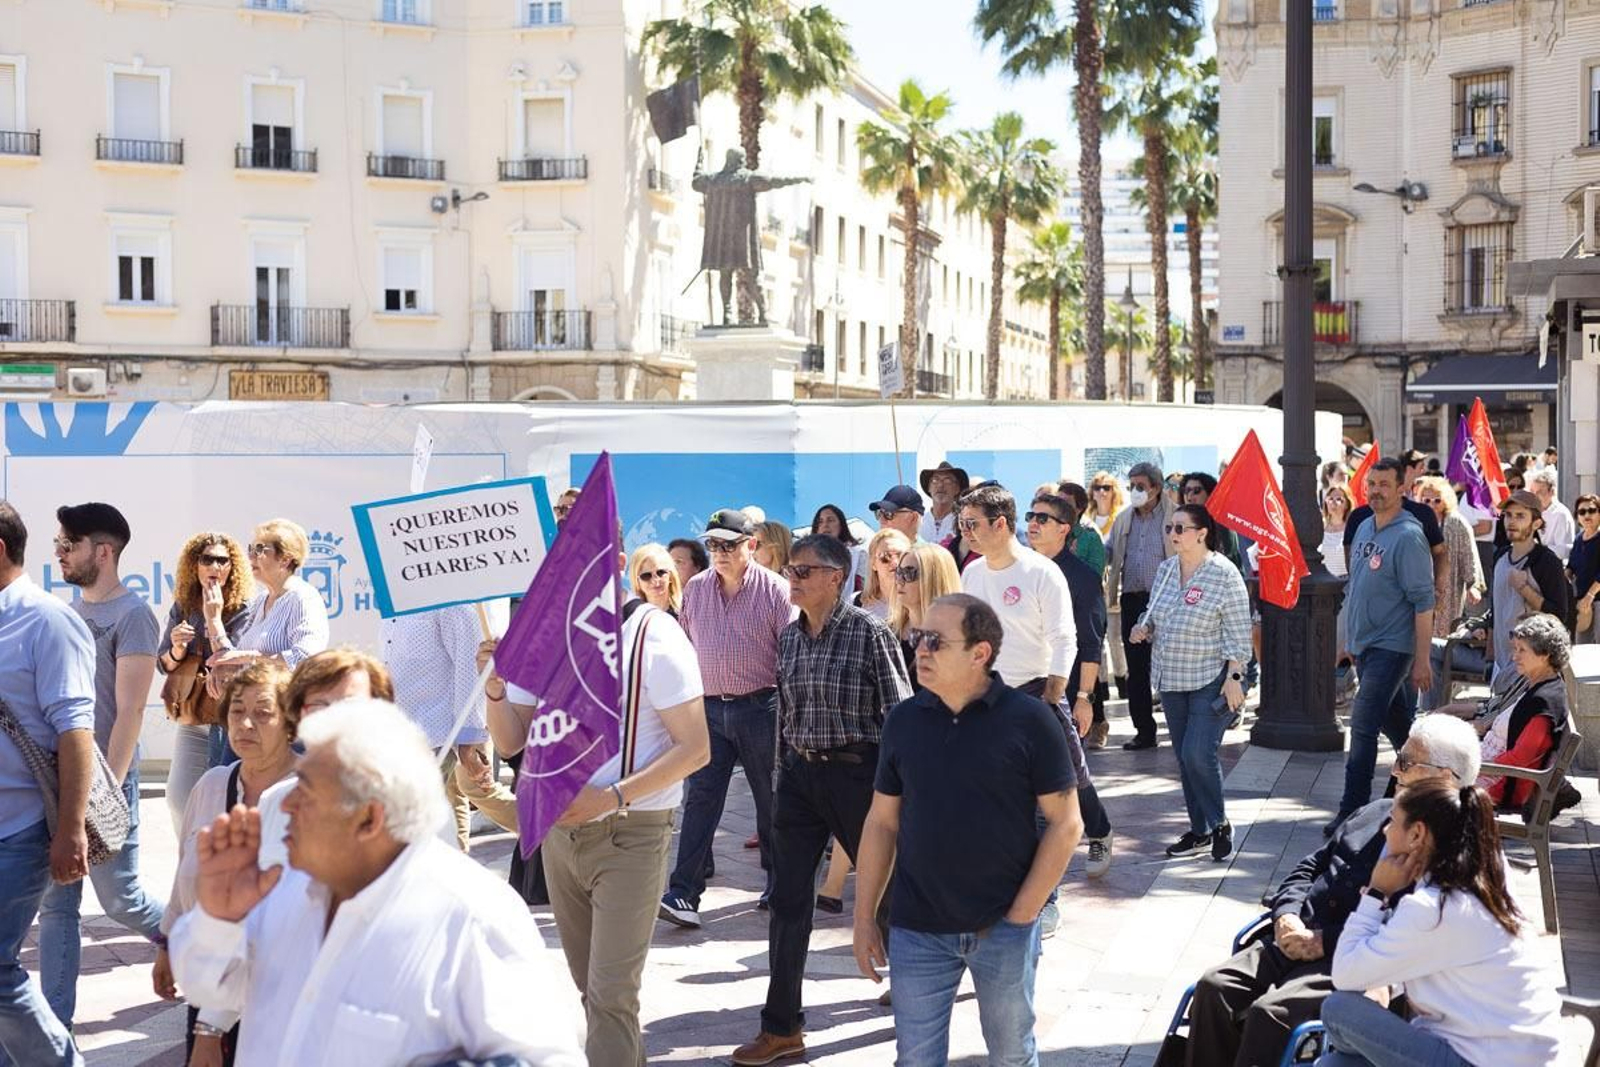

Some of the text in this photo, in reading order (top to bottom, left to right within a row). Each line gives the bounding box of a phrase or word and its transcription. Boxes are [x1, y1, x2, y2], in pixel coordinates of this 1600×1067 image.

[242, 374, 316, 395] LA TRAVIESA
[389, 500, 520, 537] ¡QUEREMOS
[402, 524, 517, 556] NUESTROS
[401, 548, 531, 581] CHARES YA!
